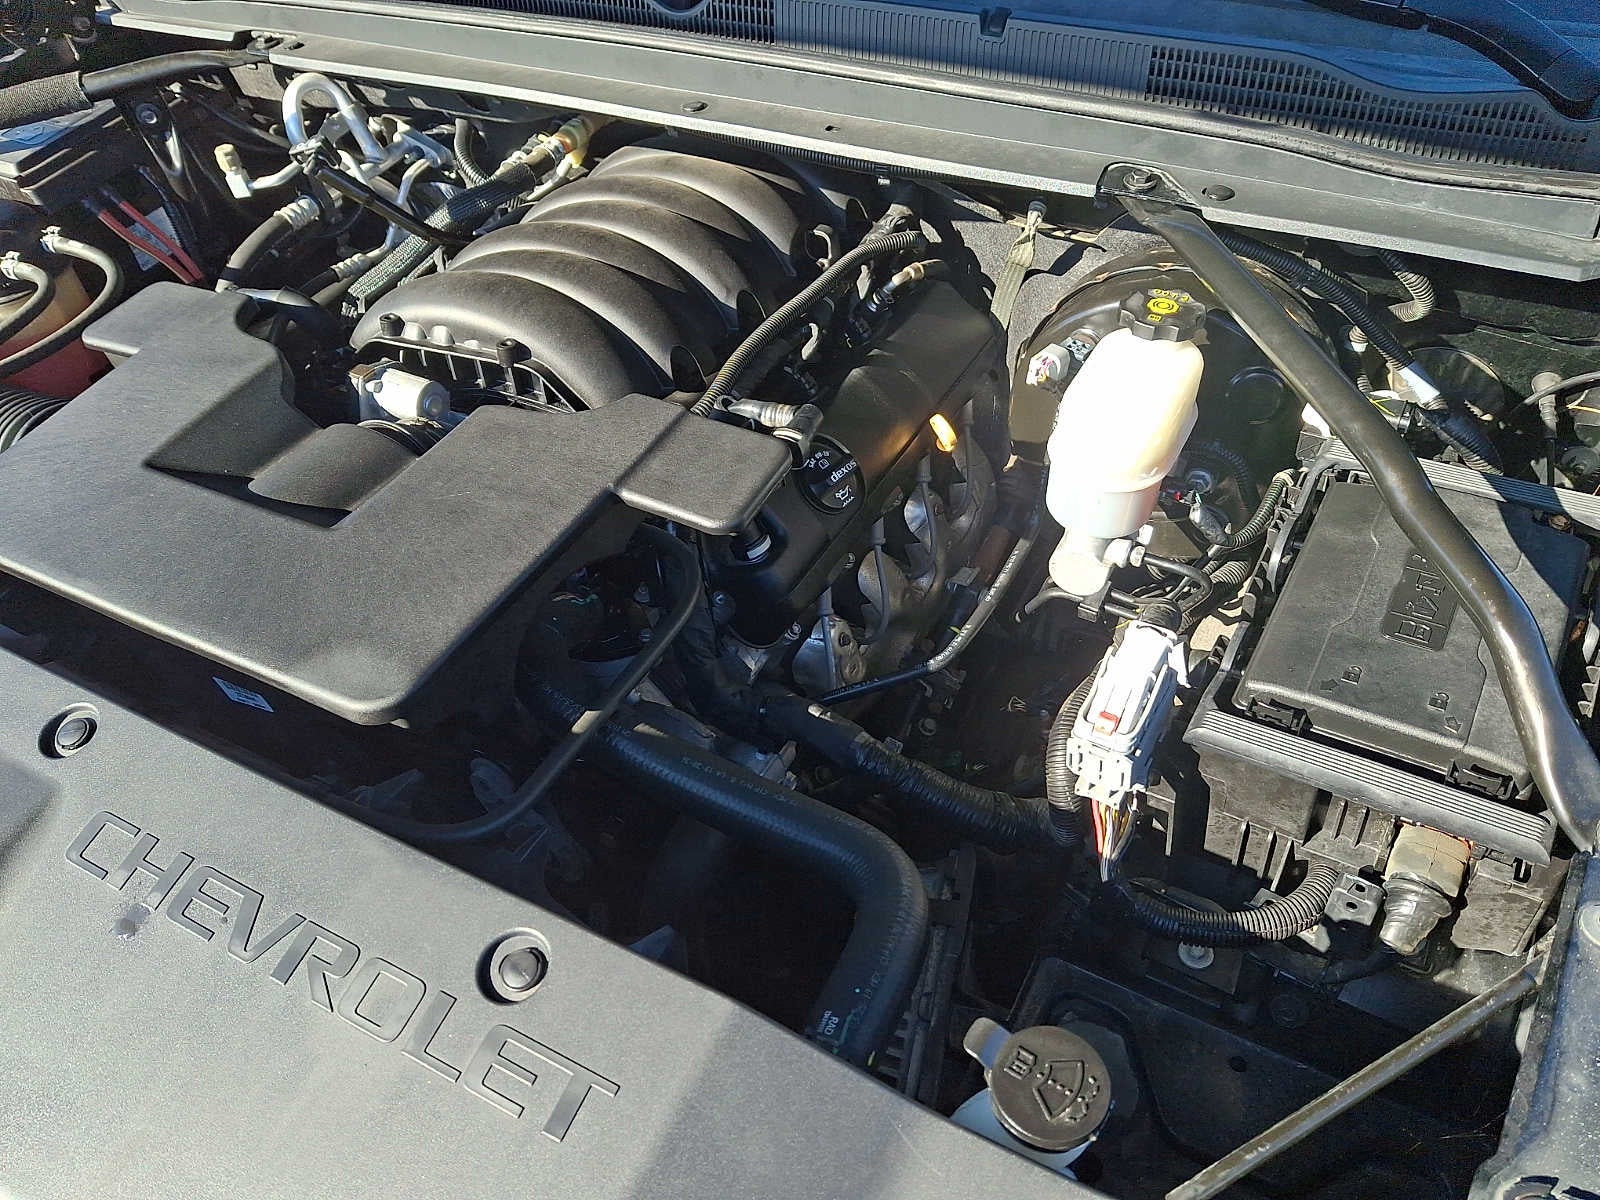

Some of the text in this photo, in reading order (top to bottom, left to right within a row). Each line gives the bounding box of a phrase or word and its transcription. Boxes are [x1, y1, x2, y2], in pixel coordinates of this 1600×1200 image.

[830, 460, 857, 482] dexos
[65, 810, 621, 1143] CHEVROLET
[824, 1016, 839, 1035] RAD
